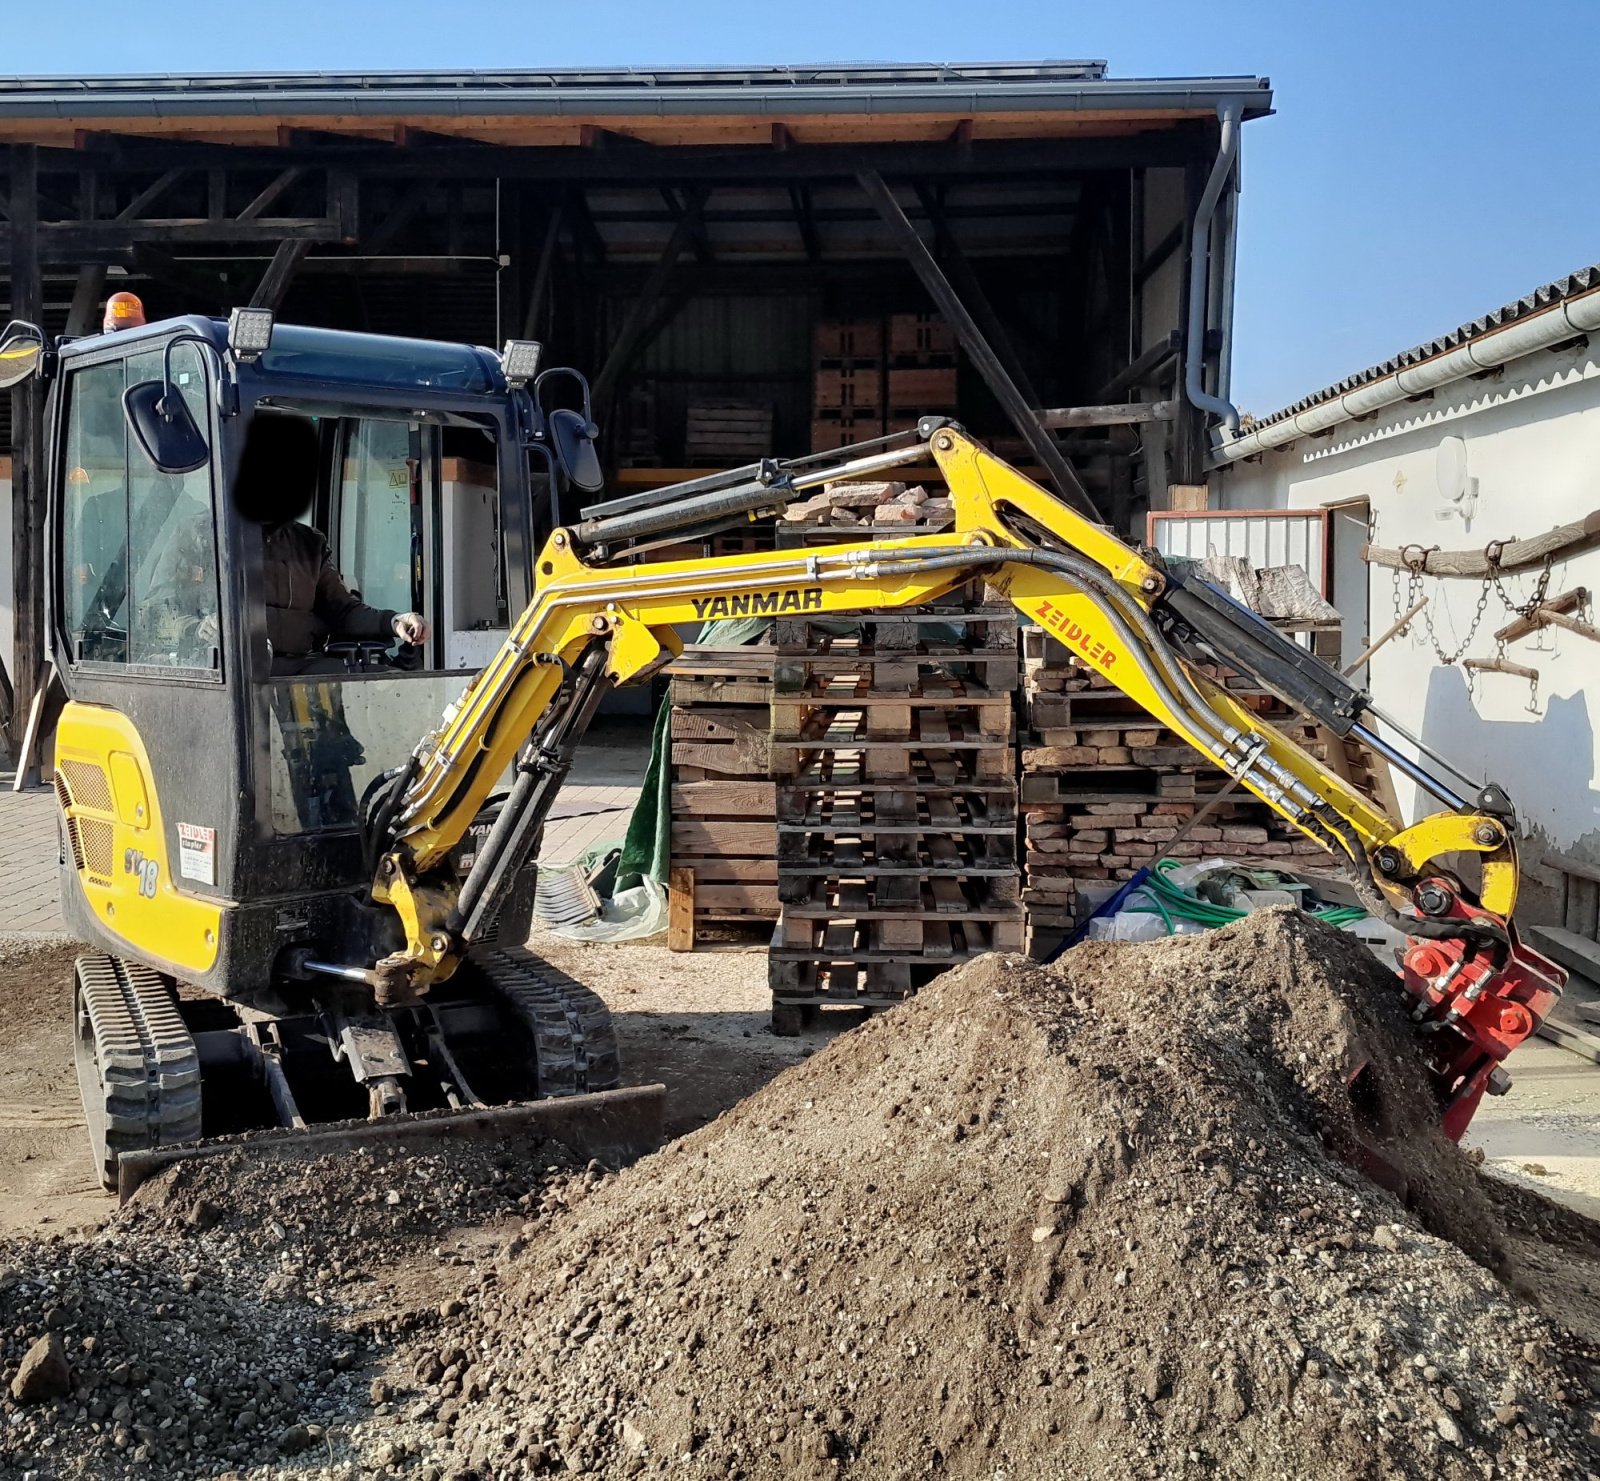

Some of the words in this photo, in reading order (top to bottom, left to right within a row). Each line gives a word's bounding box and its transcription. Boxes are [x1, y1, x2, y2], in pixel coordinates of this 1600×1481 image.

[691, 588, 823, 619] YANMAR
[1035, 600, 1117, 670] ZEIDLER
[180, 824, 214, 840] ZEIDLER
[468, 823, 495, 836] YAN
